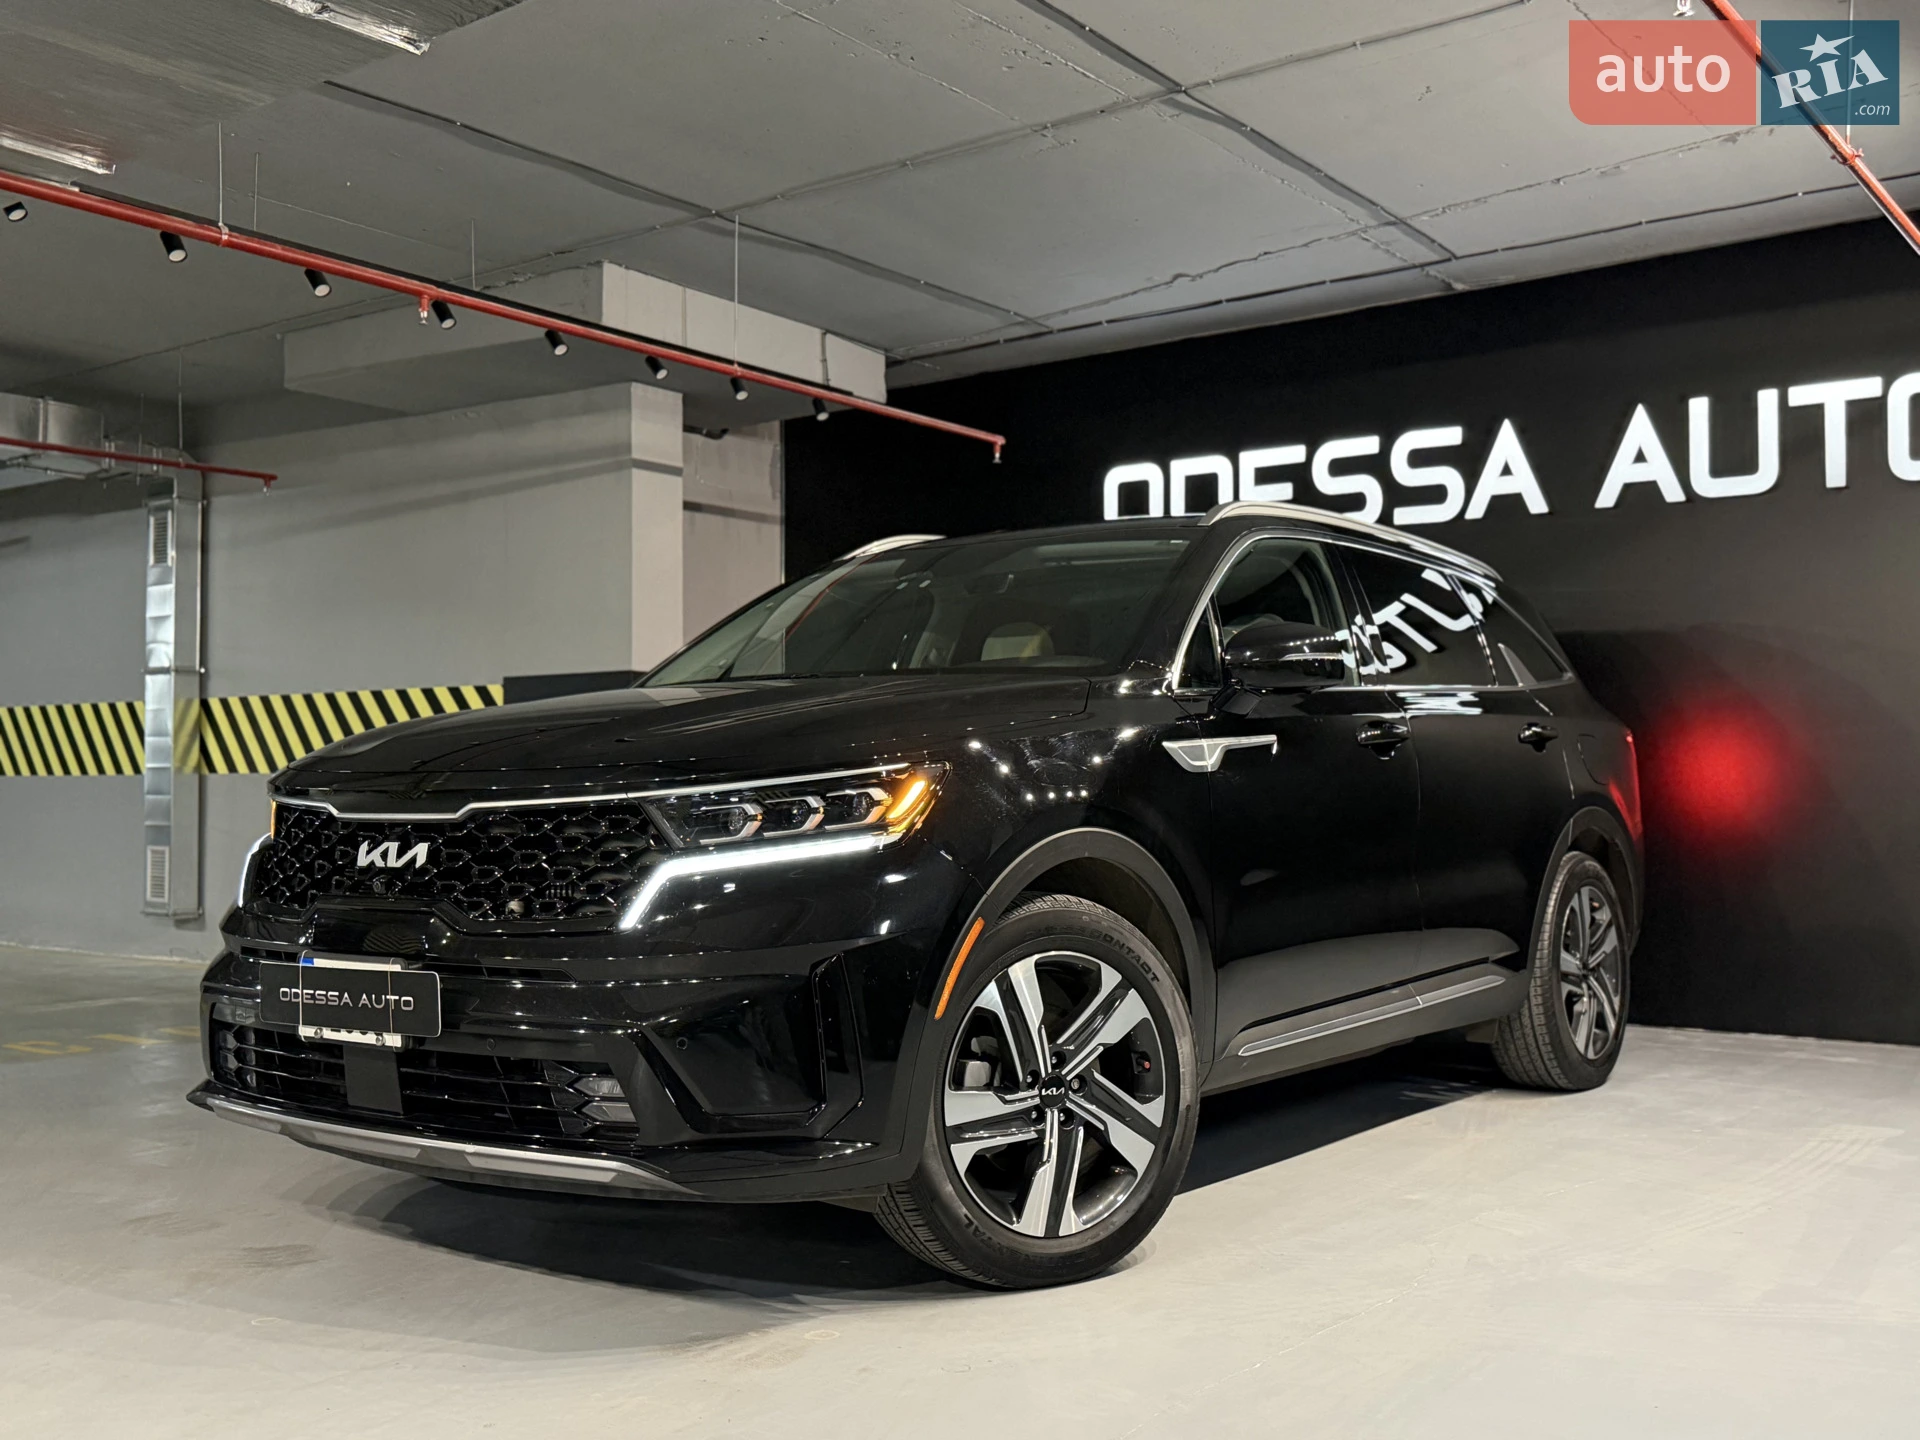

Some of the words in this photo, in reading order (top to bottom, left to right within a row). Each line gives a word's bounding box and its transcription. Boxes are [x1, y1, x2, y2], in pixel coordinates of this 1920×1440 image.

[1103, 418, 1549, 525] ODESSA
[356, 840, 431, 869] KIA
[279, 987, 353, 1008] ODESSA
[358, 992, 414, 1012] AUTO
